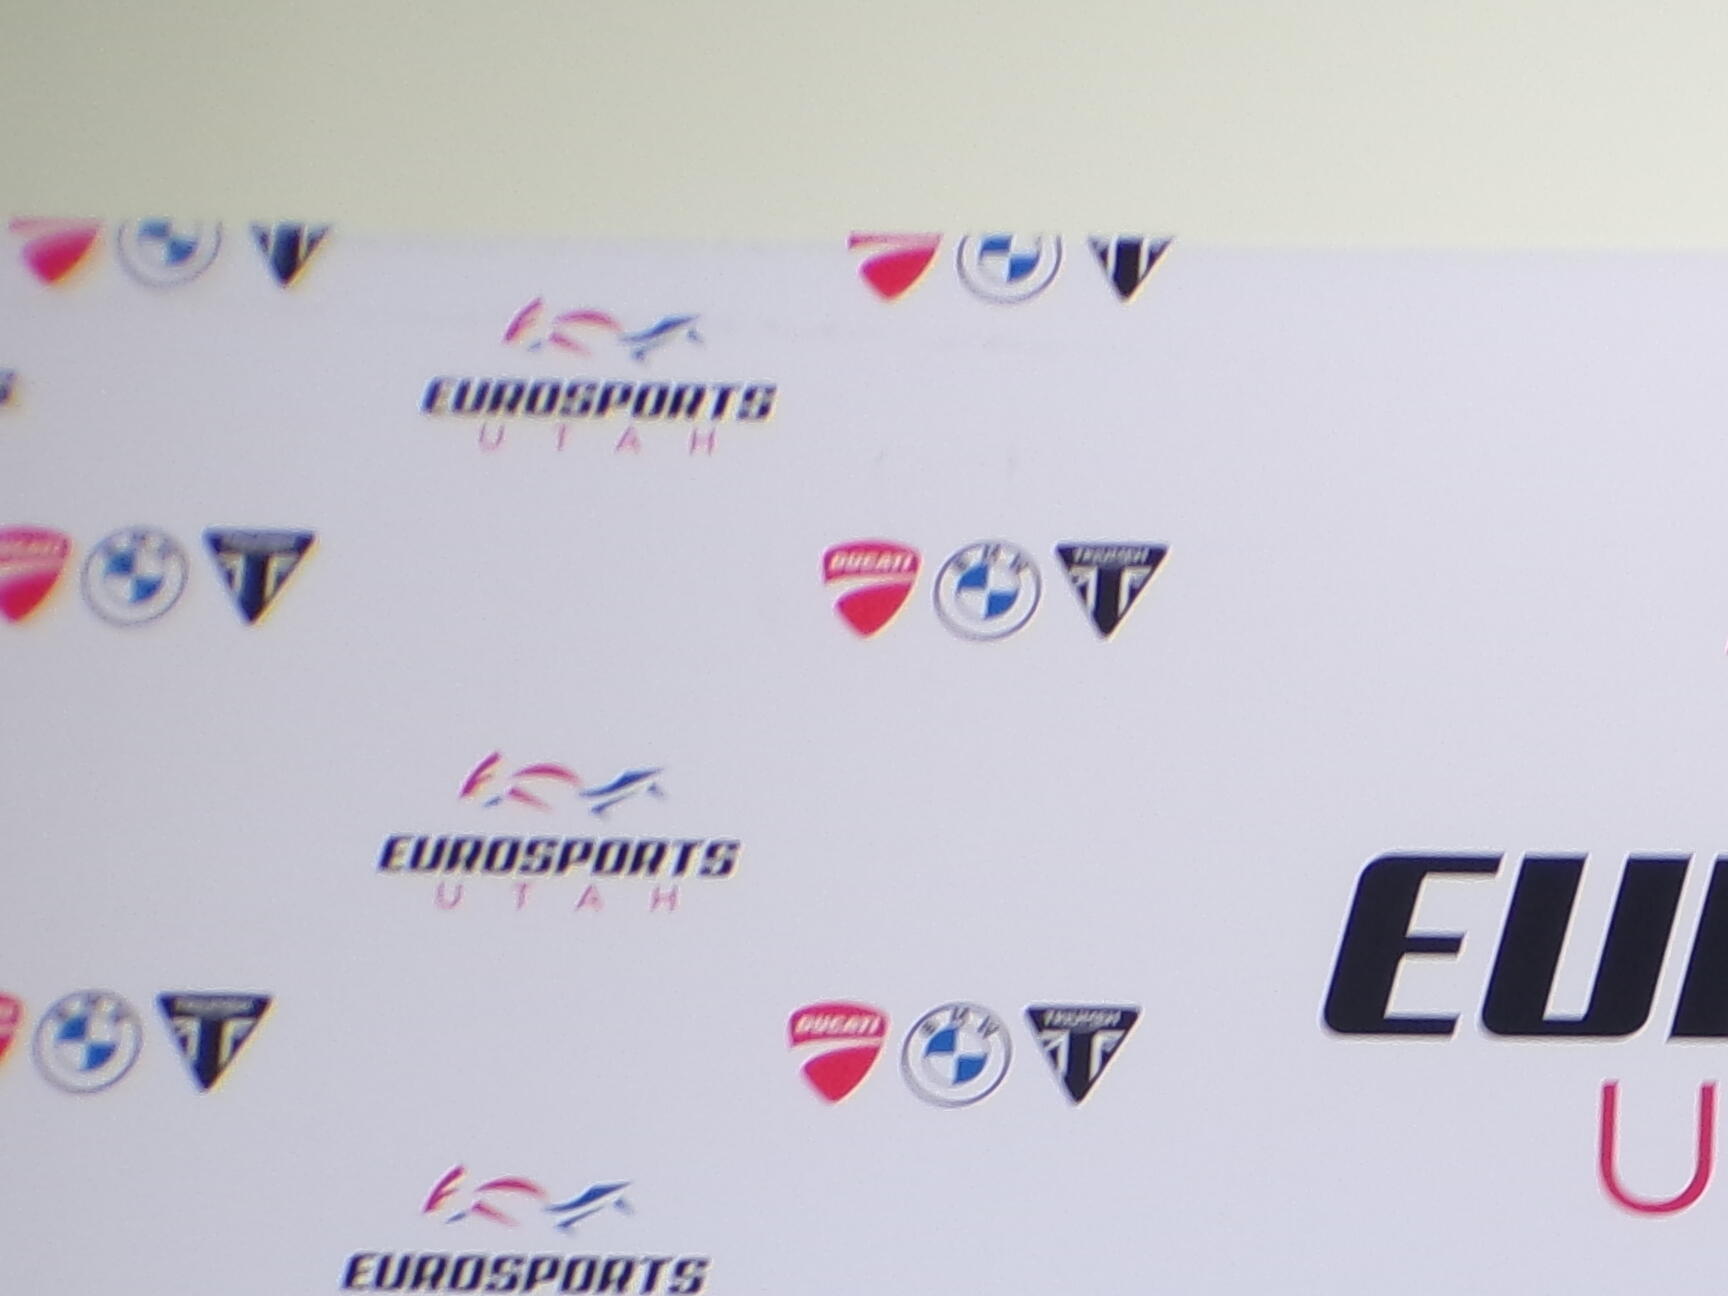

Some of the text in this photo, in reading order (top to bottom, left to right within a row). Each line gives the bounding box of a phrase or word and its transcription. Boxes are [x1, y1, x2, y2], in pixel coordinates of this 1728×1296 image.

[423, 377, 776, 421] EUROSPORTS
[478, 423, 720, 454] UTAH
[831, 551, 913, 572] DUCATI
[379, 835, 740, 877] EUROSPORTS
[434, 880, 681, 912] UTAH
[797, 1015, 880, 1035] DUCATI
[342, 1252, 708, 1296] EUROSPORTS
